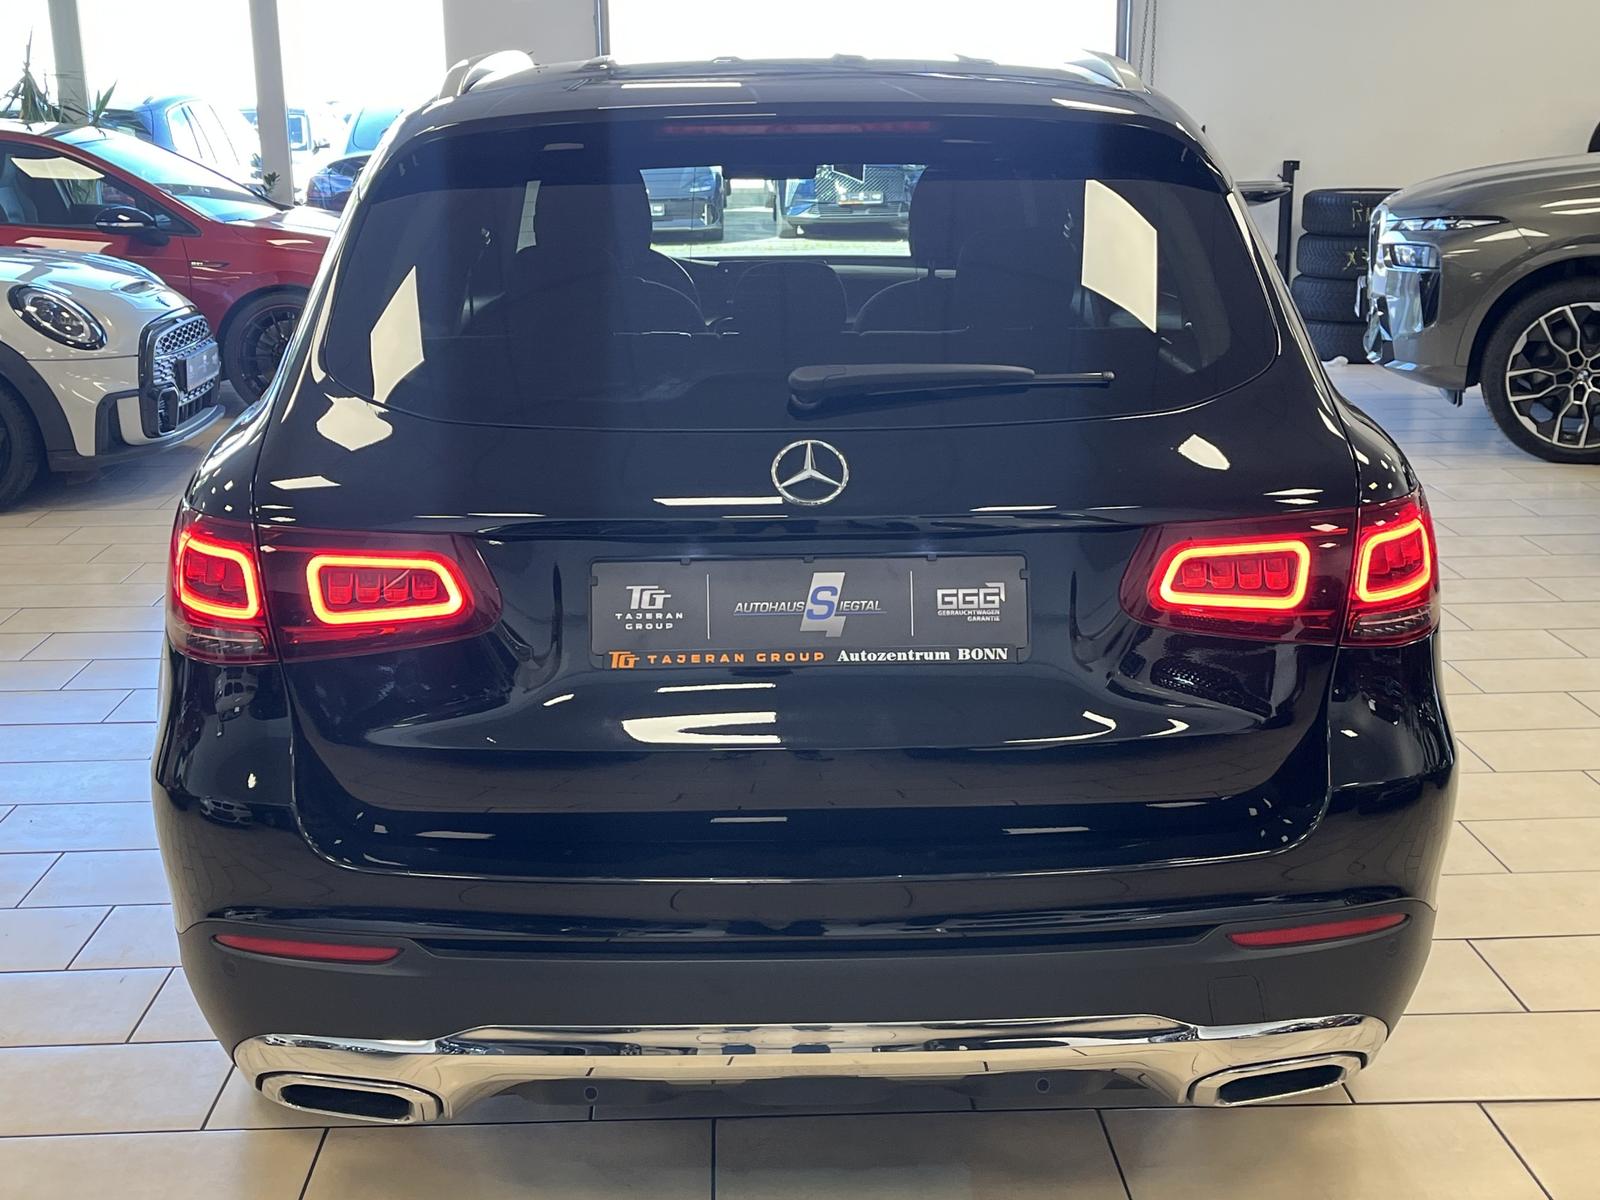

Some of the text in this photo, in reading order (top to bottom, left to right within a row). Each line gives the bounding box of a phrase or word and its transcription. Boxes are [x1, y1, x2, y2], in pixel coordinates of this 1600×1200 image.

[936, 588, 1001, 610] GGG
[734, 601, 806, 614] AUTOHAUS
[615, 612, 684, 620] TAJERAN
[937, 609, 1000, 617] GEBRAUCHTWAGEN
[625, 622, 673, 630] GROUP
[647, 652, 745, 664] TAJERAN
[756, 650, 825, 663] GROUP
[837, 649, 950, 662] Autozentrum
[957, 647, 1008, 661] BONN
